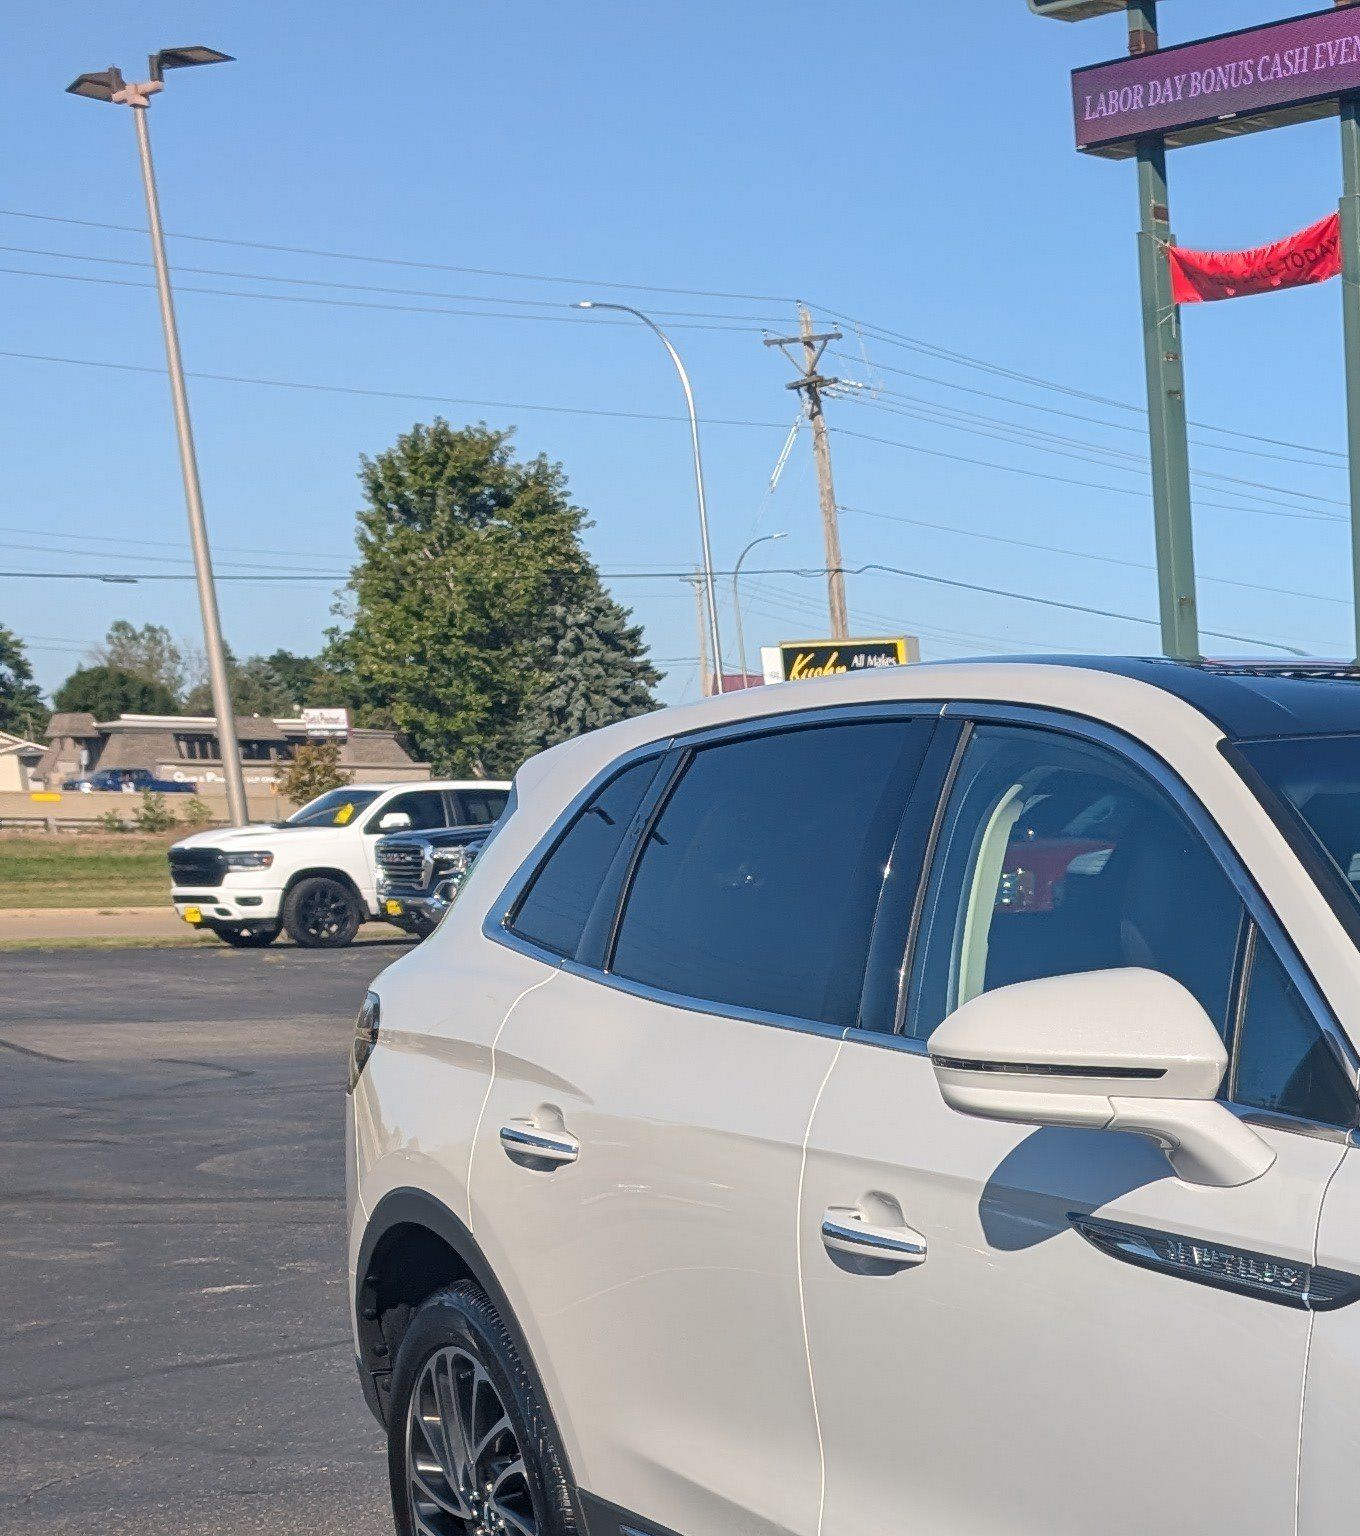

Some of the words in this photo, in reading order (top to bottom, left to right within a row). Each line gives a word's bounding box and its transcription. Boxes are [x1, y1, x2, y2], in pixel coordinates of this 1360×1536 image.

[1084, 84, 1143, 121] LABOR
[1147, 73, 1190, 108] DAY
[1189, 59, 1254, 98] BONUS
[1256, 46, 1312, 83] CASH
[789, 651, 847, 681] Kuehn
[851, 654, 865, 668] All
